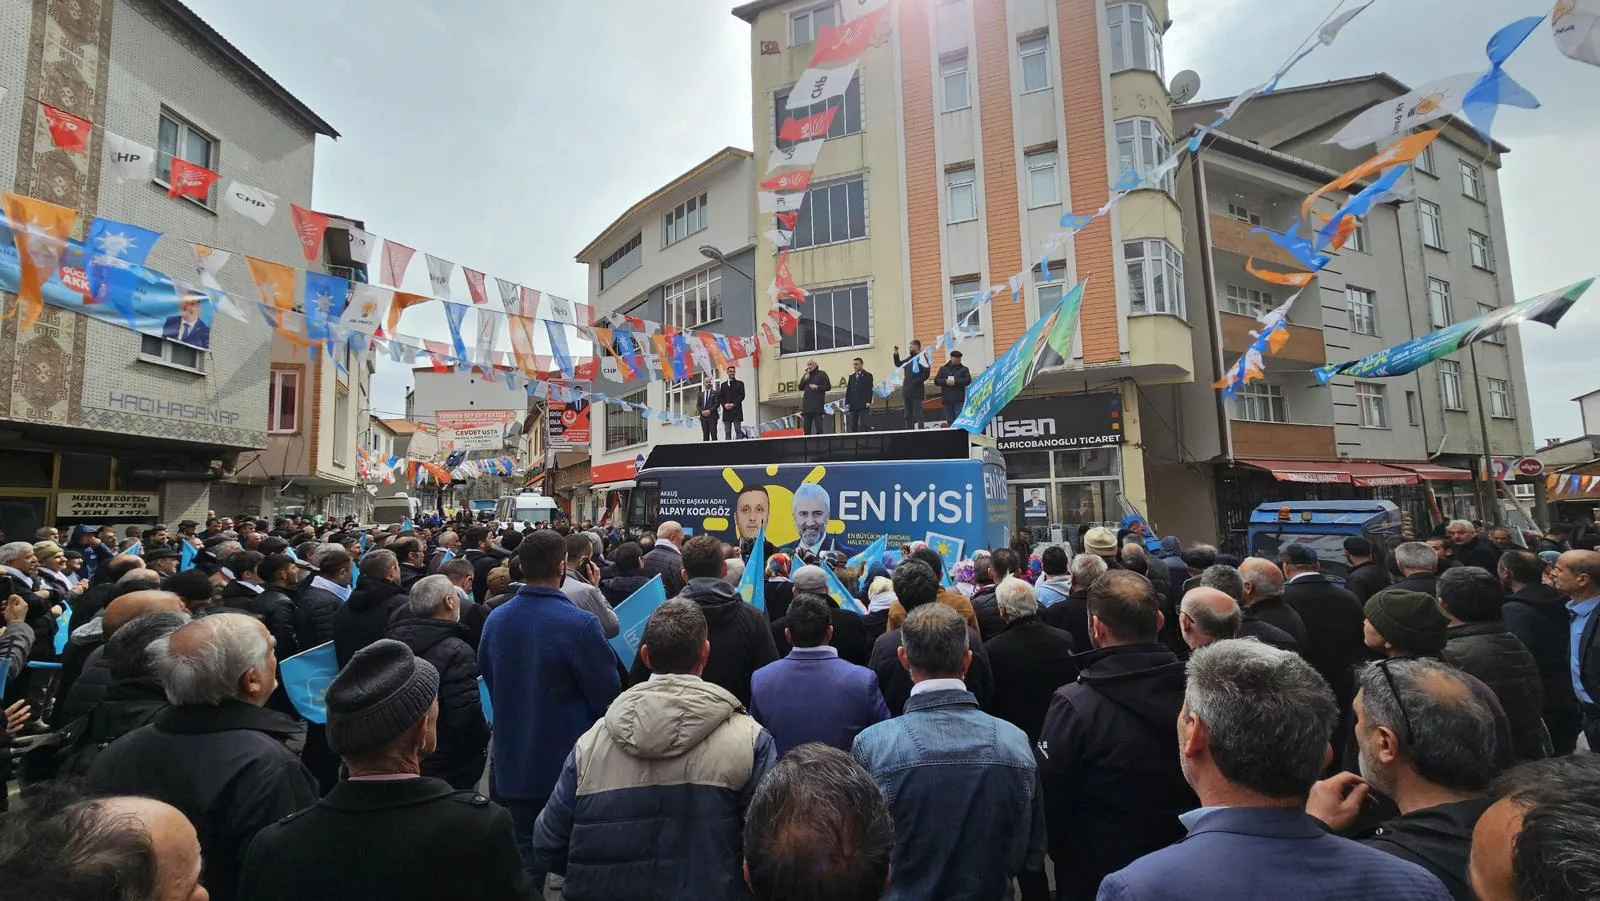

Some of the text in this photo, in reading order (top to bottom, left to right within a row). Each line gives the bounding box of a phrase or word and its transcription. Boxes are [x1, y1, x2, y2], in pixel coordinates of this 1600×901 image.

[236, 192, 266, 208] CHP
[686, 498, 709, 506] BAŞKAN
[839, 491, 886, 521] EN
[893, 483, 973, 524] İYİSİ
[659, 506, 731, 516] ALPAY KOCAGÖZ
